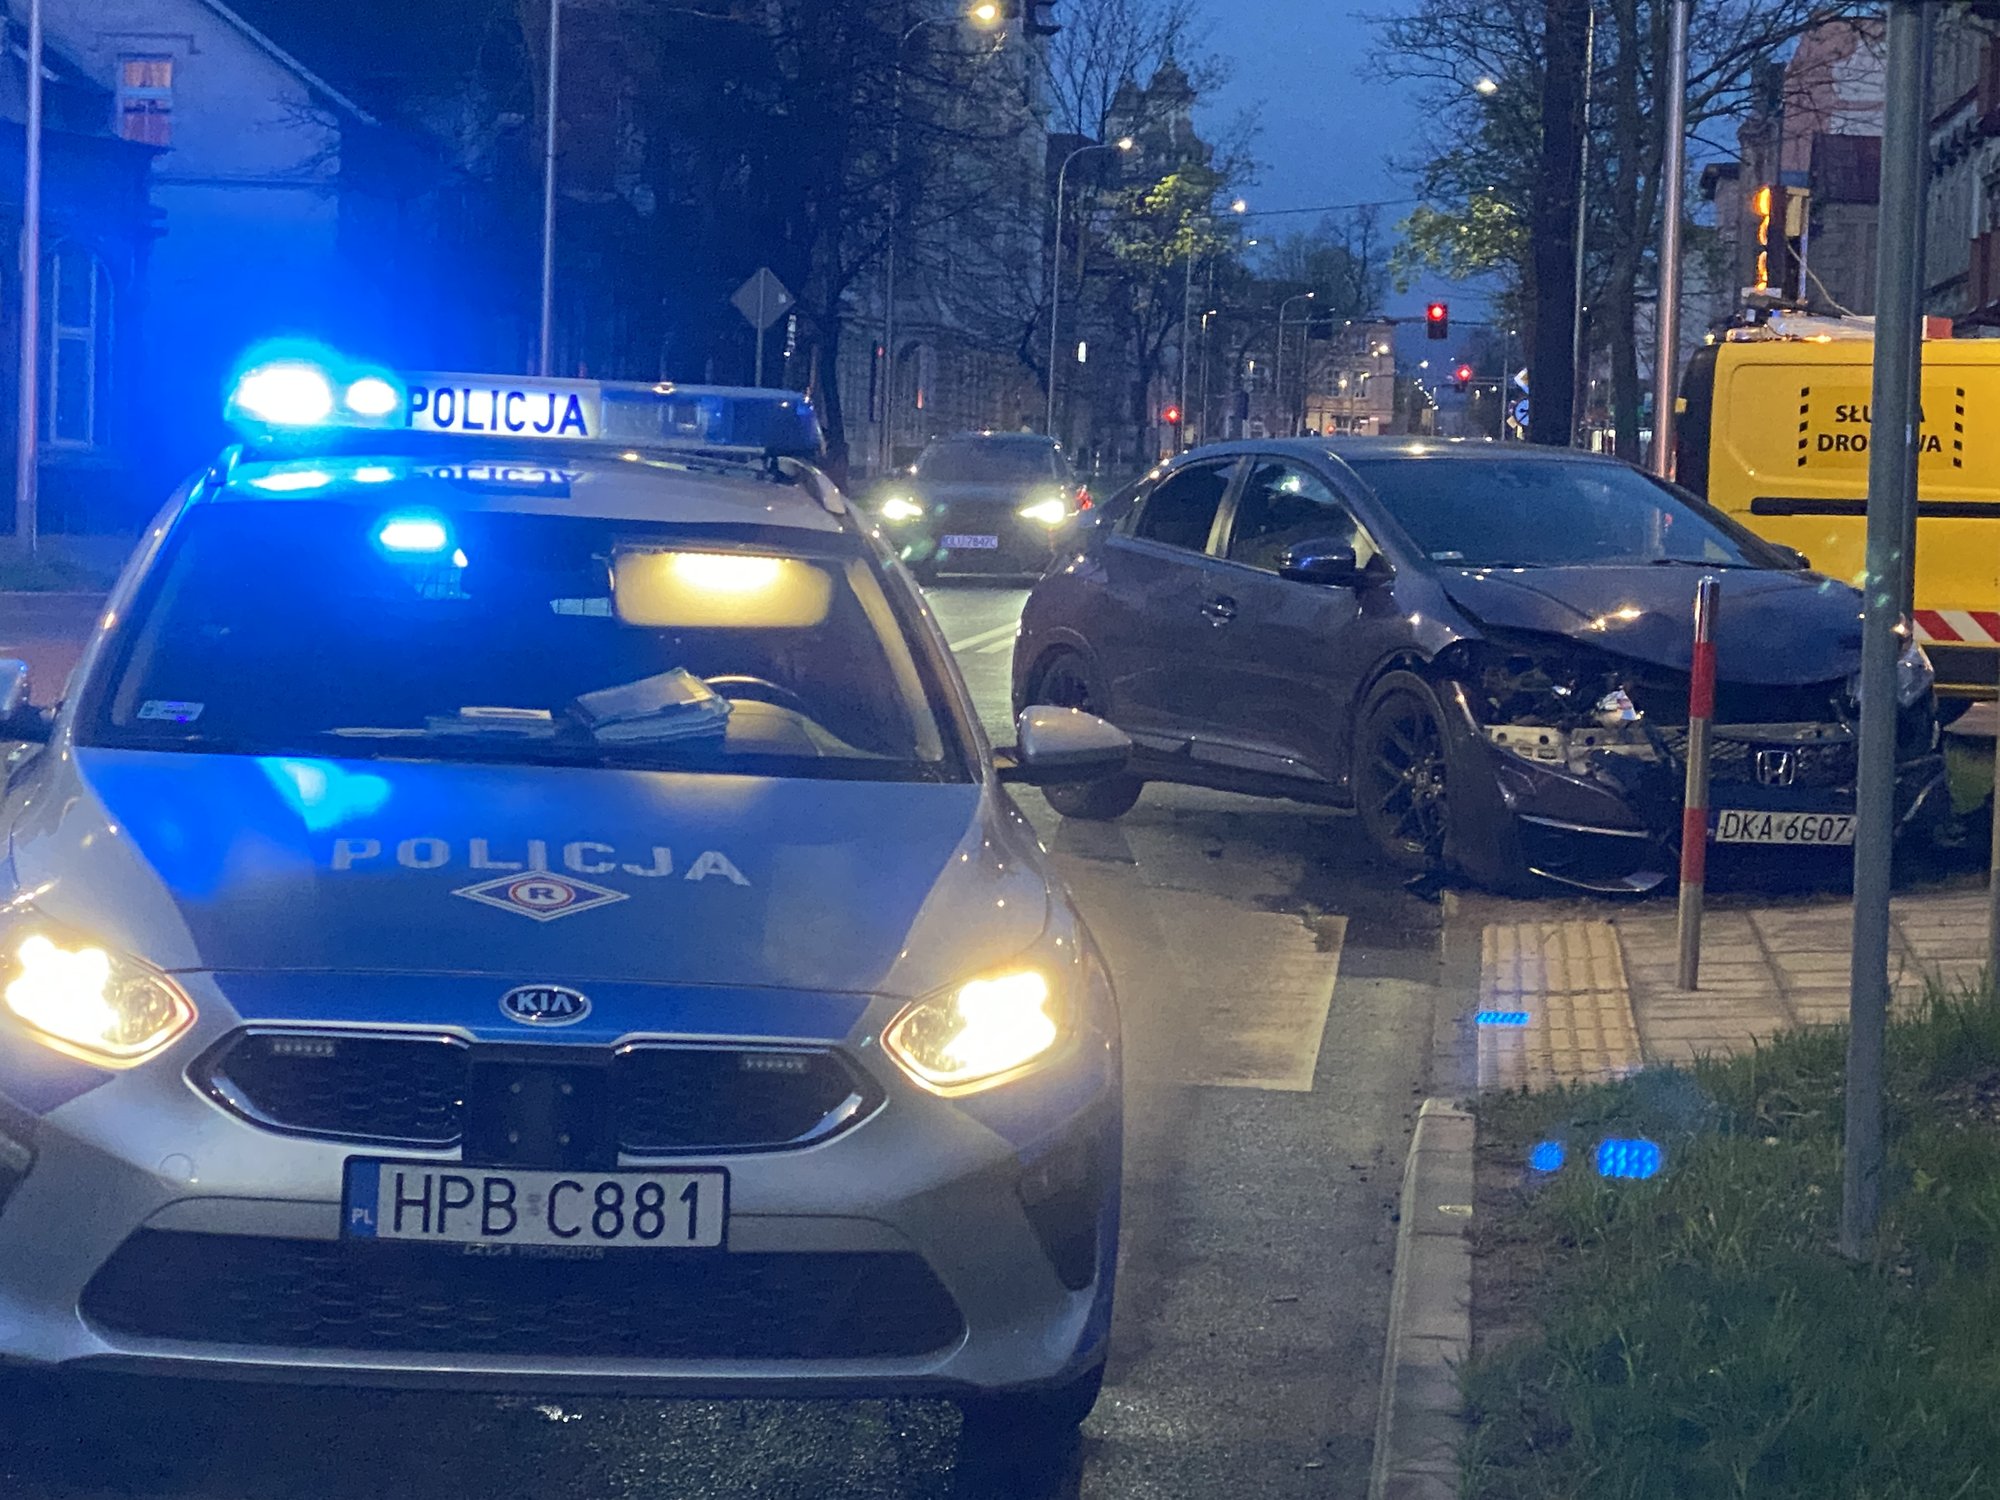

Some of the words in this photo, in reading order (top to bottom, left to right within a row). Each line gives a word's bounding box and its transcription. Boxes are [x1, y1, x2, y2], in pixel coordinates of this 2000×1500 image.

[405, 386, 588, 436] POLICJA
[1835, 404, 1926, 423] SŁU
[1817, 433, 1942, 453] DROA
[1722, 813, 1772, 840] DKA
[1784, 815, 1851, 842] 6G07
[331, 838, 750, 887] POLICJA
[528, 886, 555, 900] R
[516, 991, 573, 1013] KIA
[351, 1207, 374, 1225] PL
[393, 1172, 518, 1237] HPB
[547, 1179, 699, 1241] C881
